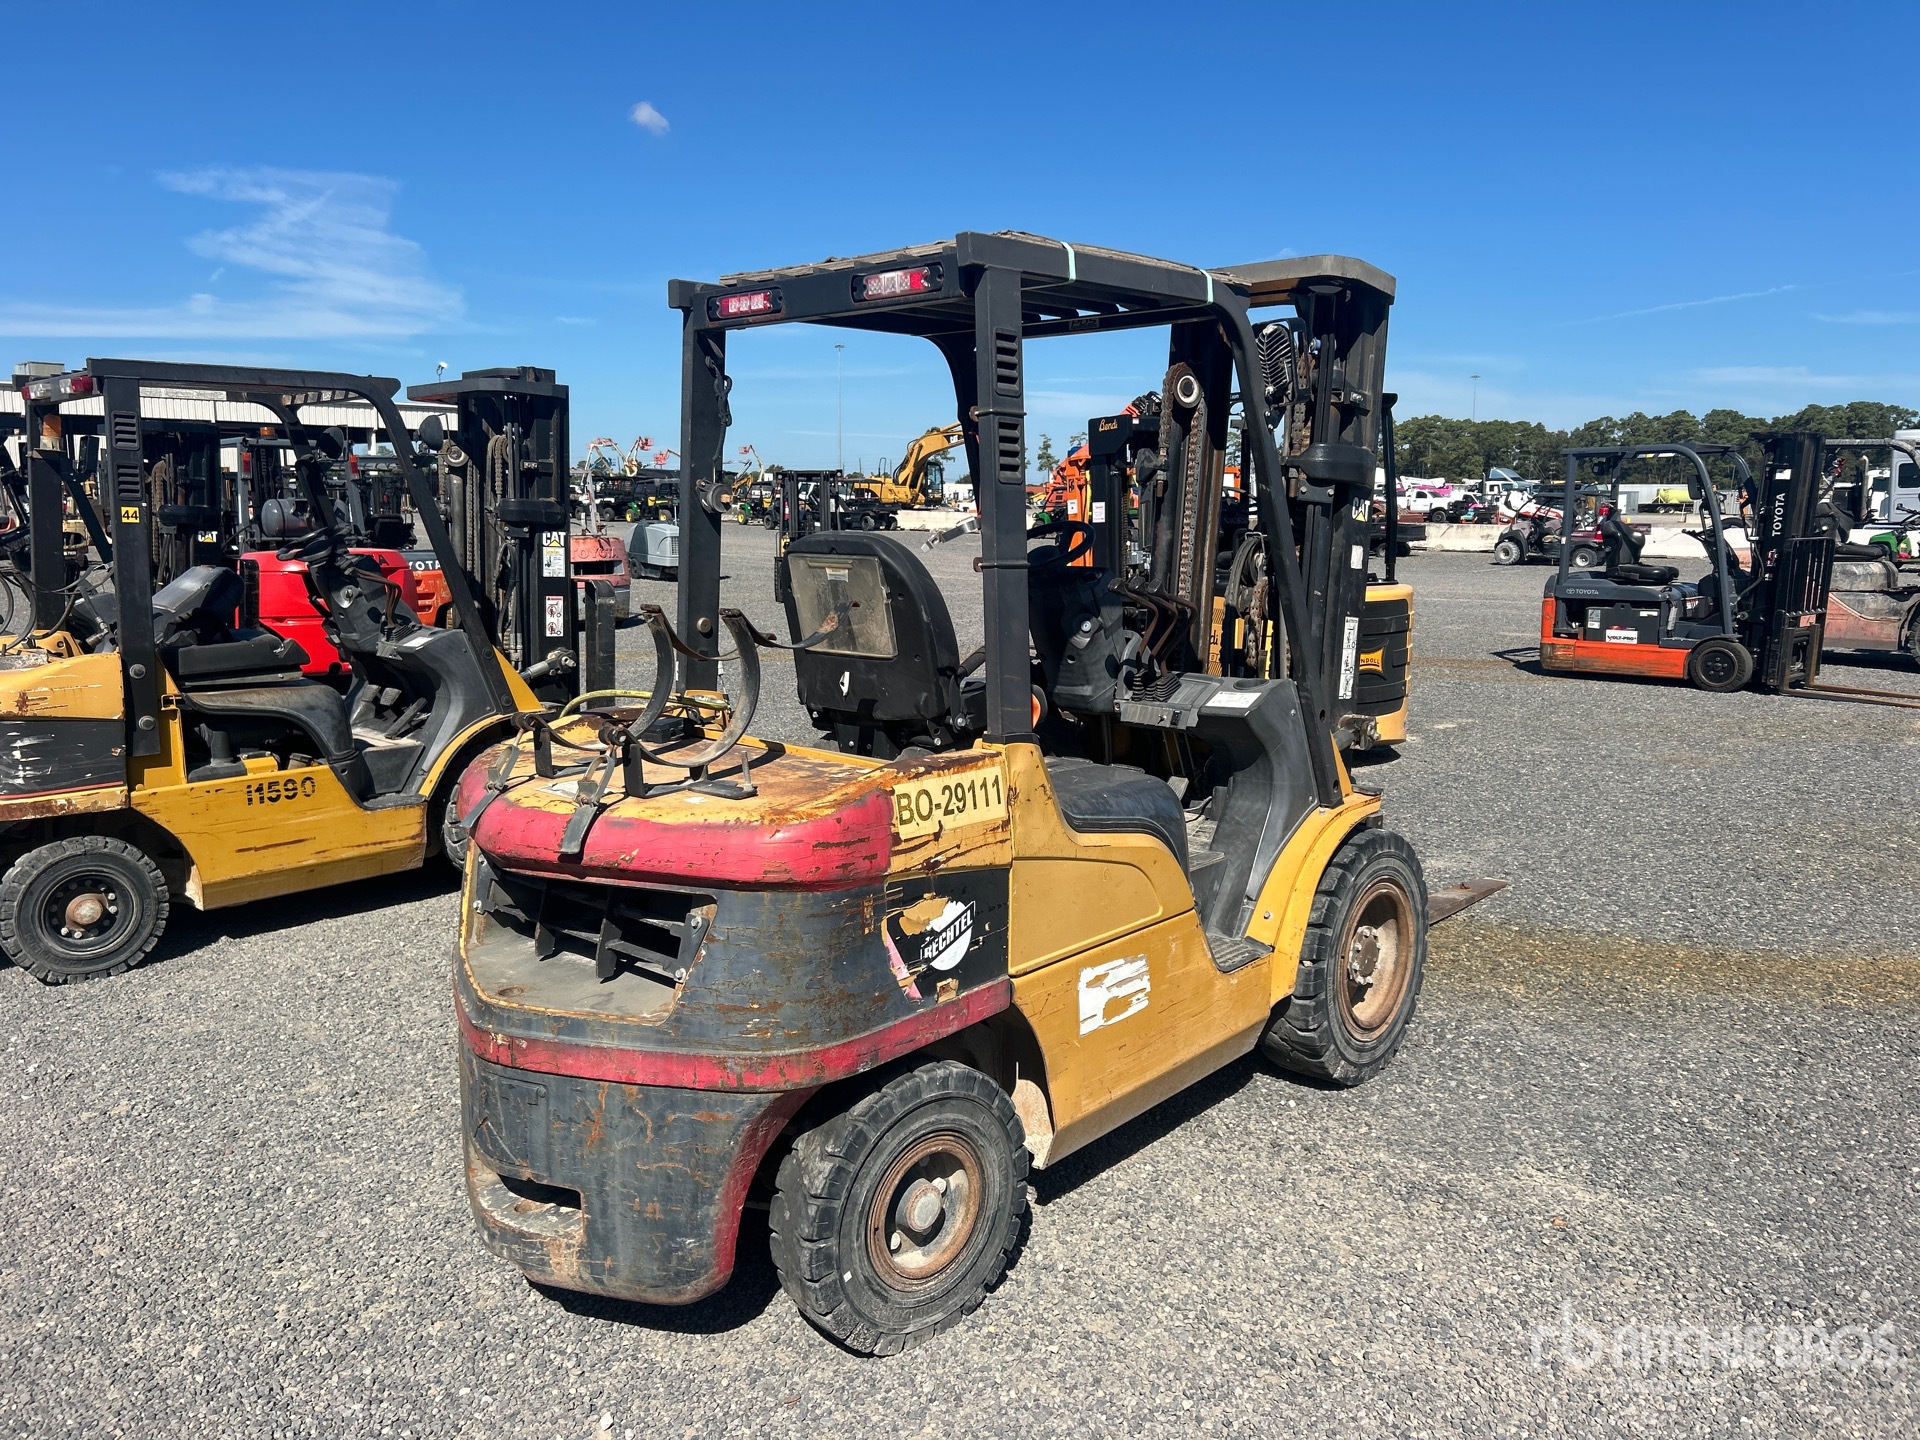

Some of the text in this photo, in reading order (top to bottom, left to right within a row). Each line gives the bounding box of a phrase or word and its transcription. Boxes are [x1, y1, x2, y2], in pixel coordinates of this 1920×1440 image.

[122, 509, 139, 520] 44
[1352, 496, 1371, 522] CAT
[1772, 493, 1786, 537] TOYOTA
[197, 530, 218, 542] CAT
[542, 531, 567, 547] CAT
[408, 560, 441, 571] YOTA
[1360, 657, 1380, 665] NDOLL
[895, 774, 1002, 827] BO-29111
